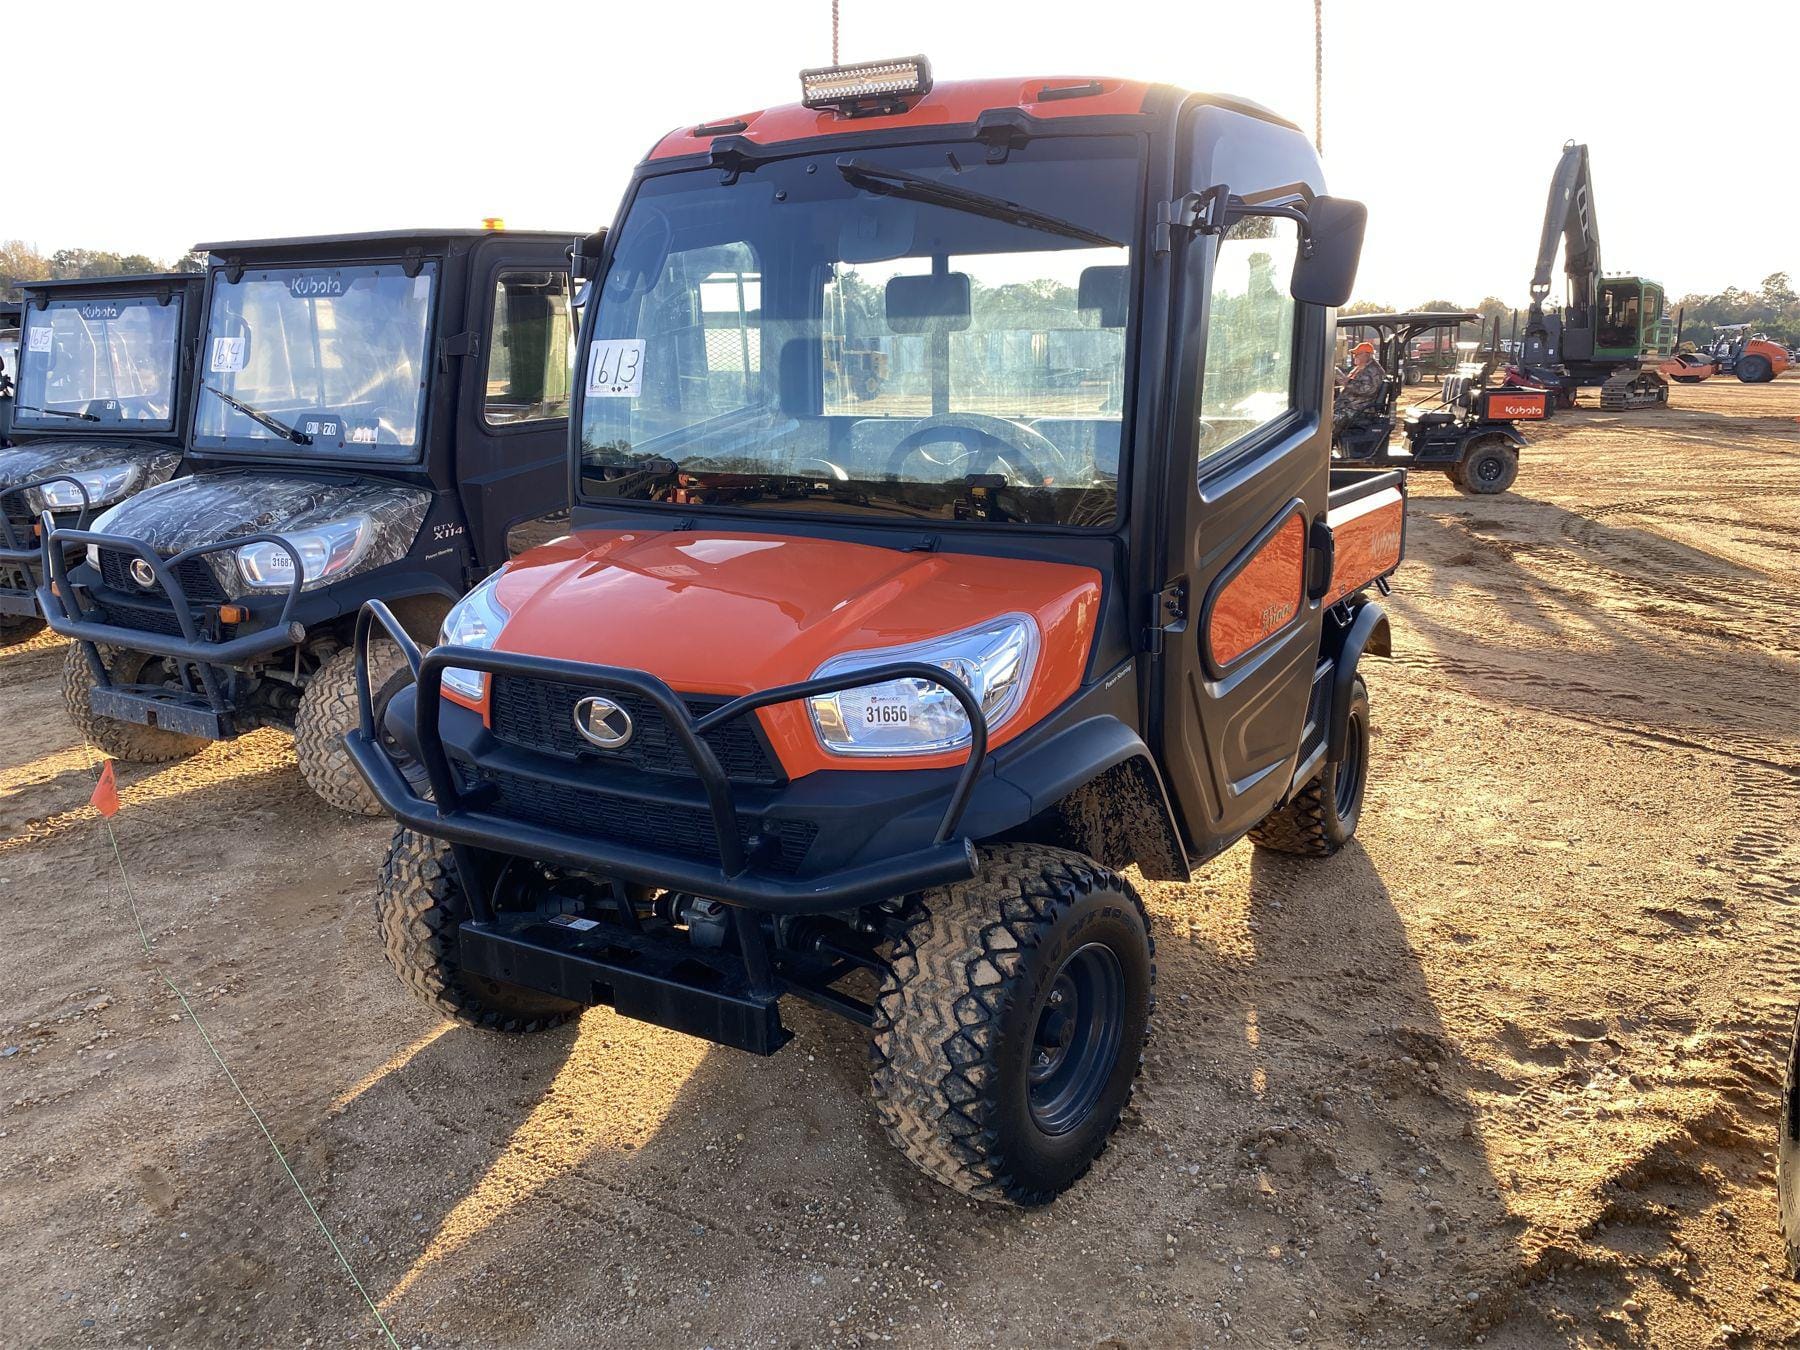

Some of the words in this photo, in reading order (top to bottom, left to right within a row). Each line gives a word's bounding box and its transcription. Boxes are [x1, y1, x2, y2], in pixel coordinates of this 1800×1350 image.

[291, 276, 342, 295] Kubota
[82, 306, 118, 318] Kubota
[214, 341, 241, 364] 1614
[590, 347, 640, 384] 1613
[1505, 405, 1542, 415] Kubota
[433, 522, 454, 532] RTV
[271, 557, 293, 568] 31687
[866, 705, 908, 723] 31656
